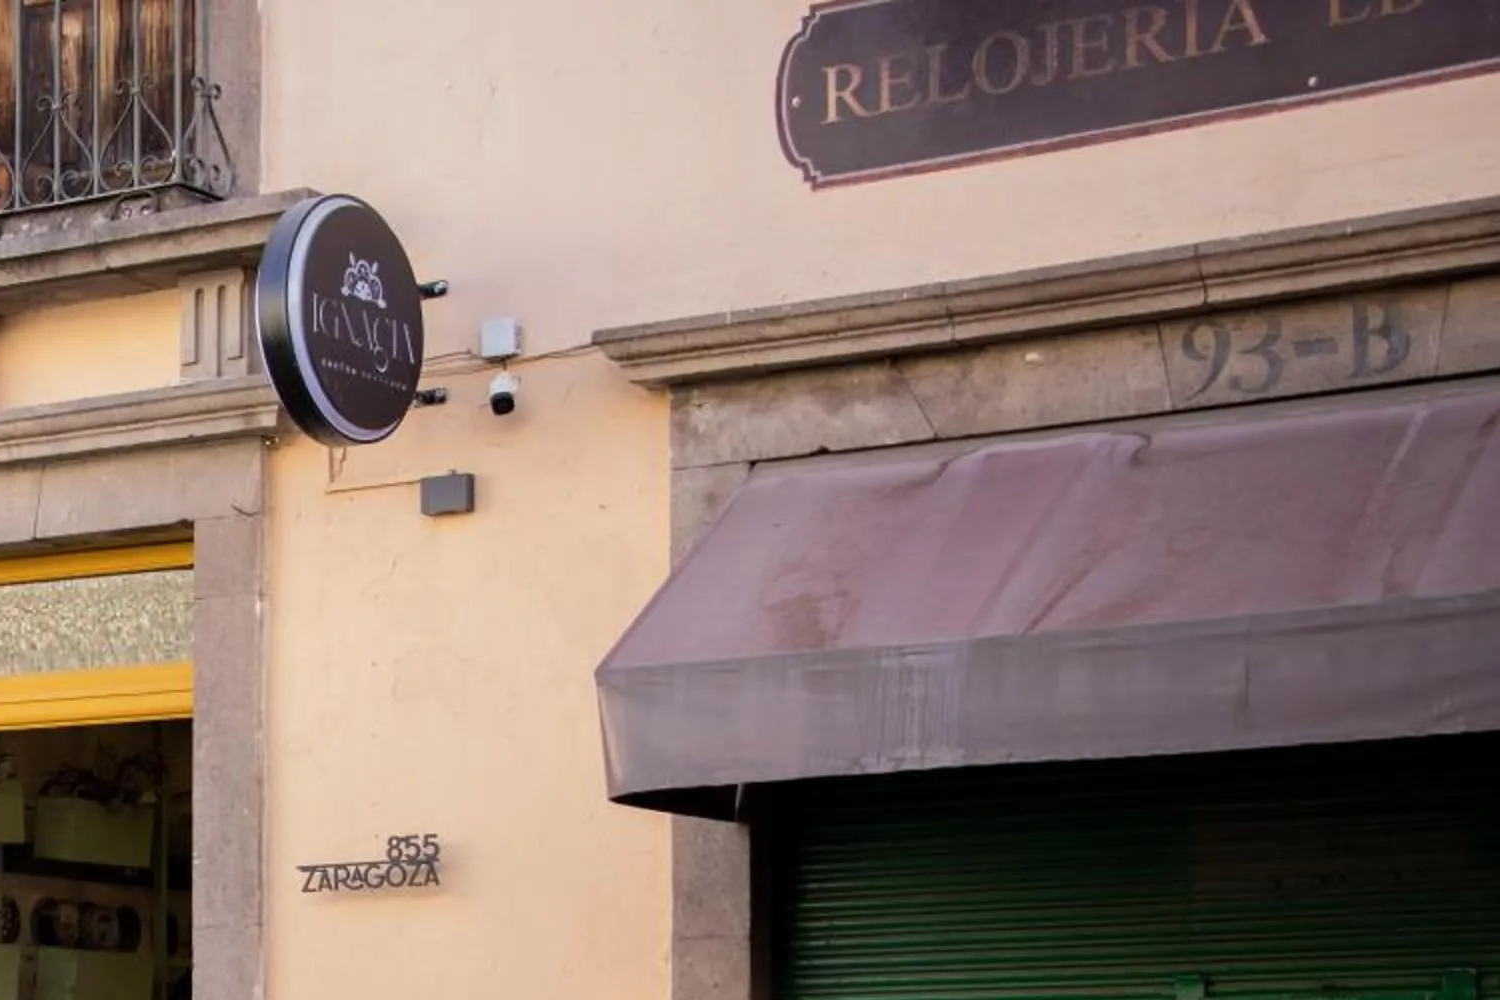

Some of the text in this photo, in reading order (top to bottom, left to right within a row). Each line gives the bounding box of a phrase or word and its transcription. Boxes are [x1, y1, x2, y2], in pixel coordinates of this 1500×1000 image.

[819, 0, 1268, 125] RELOJERIA
[1180, 298, 1411, 402] 93-B
[297, 860, 440, 893] ZARAGOZA
[387, 833, 440, 864] 855
